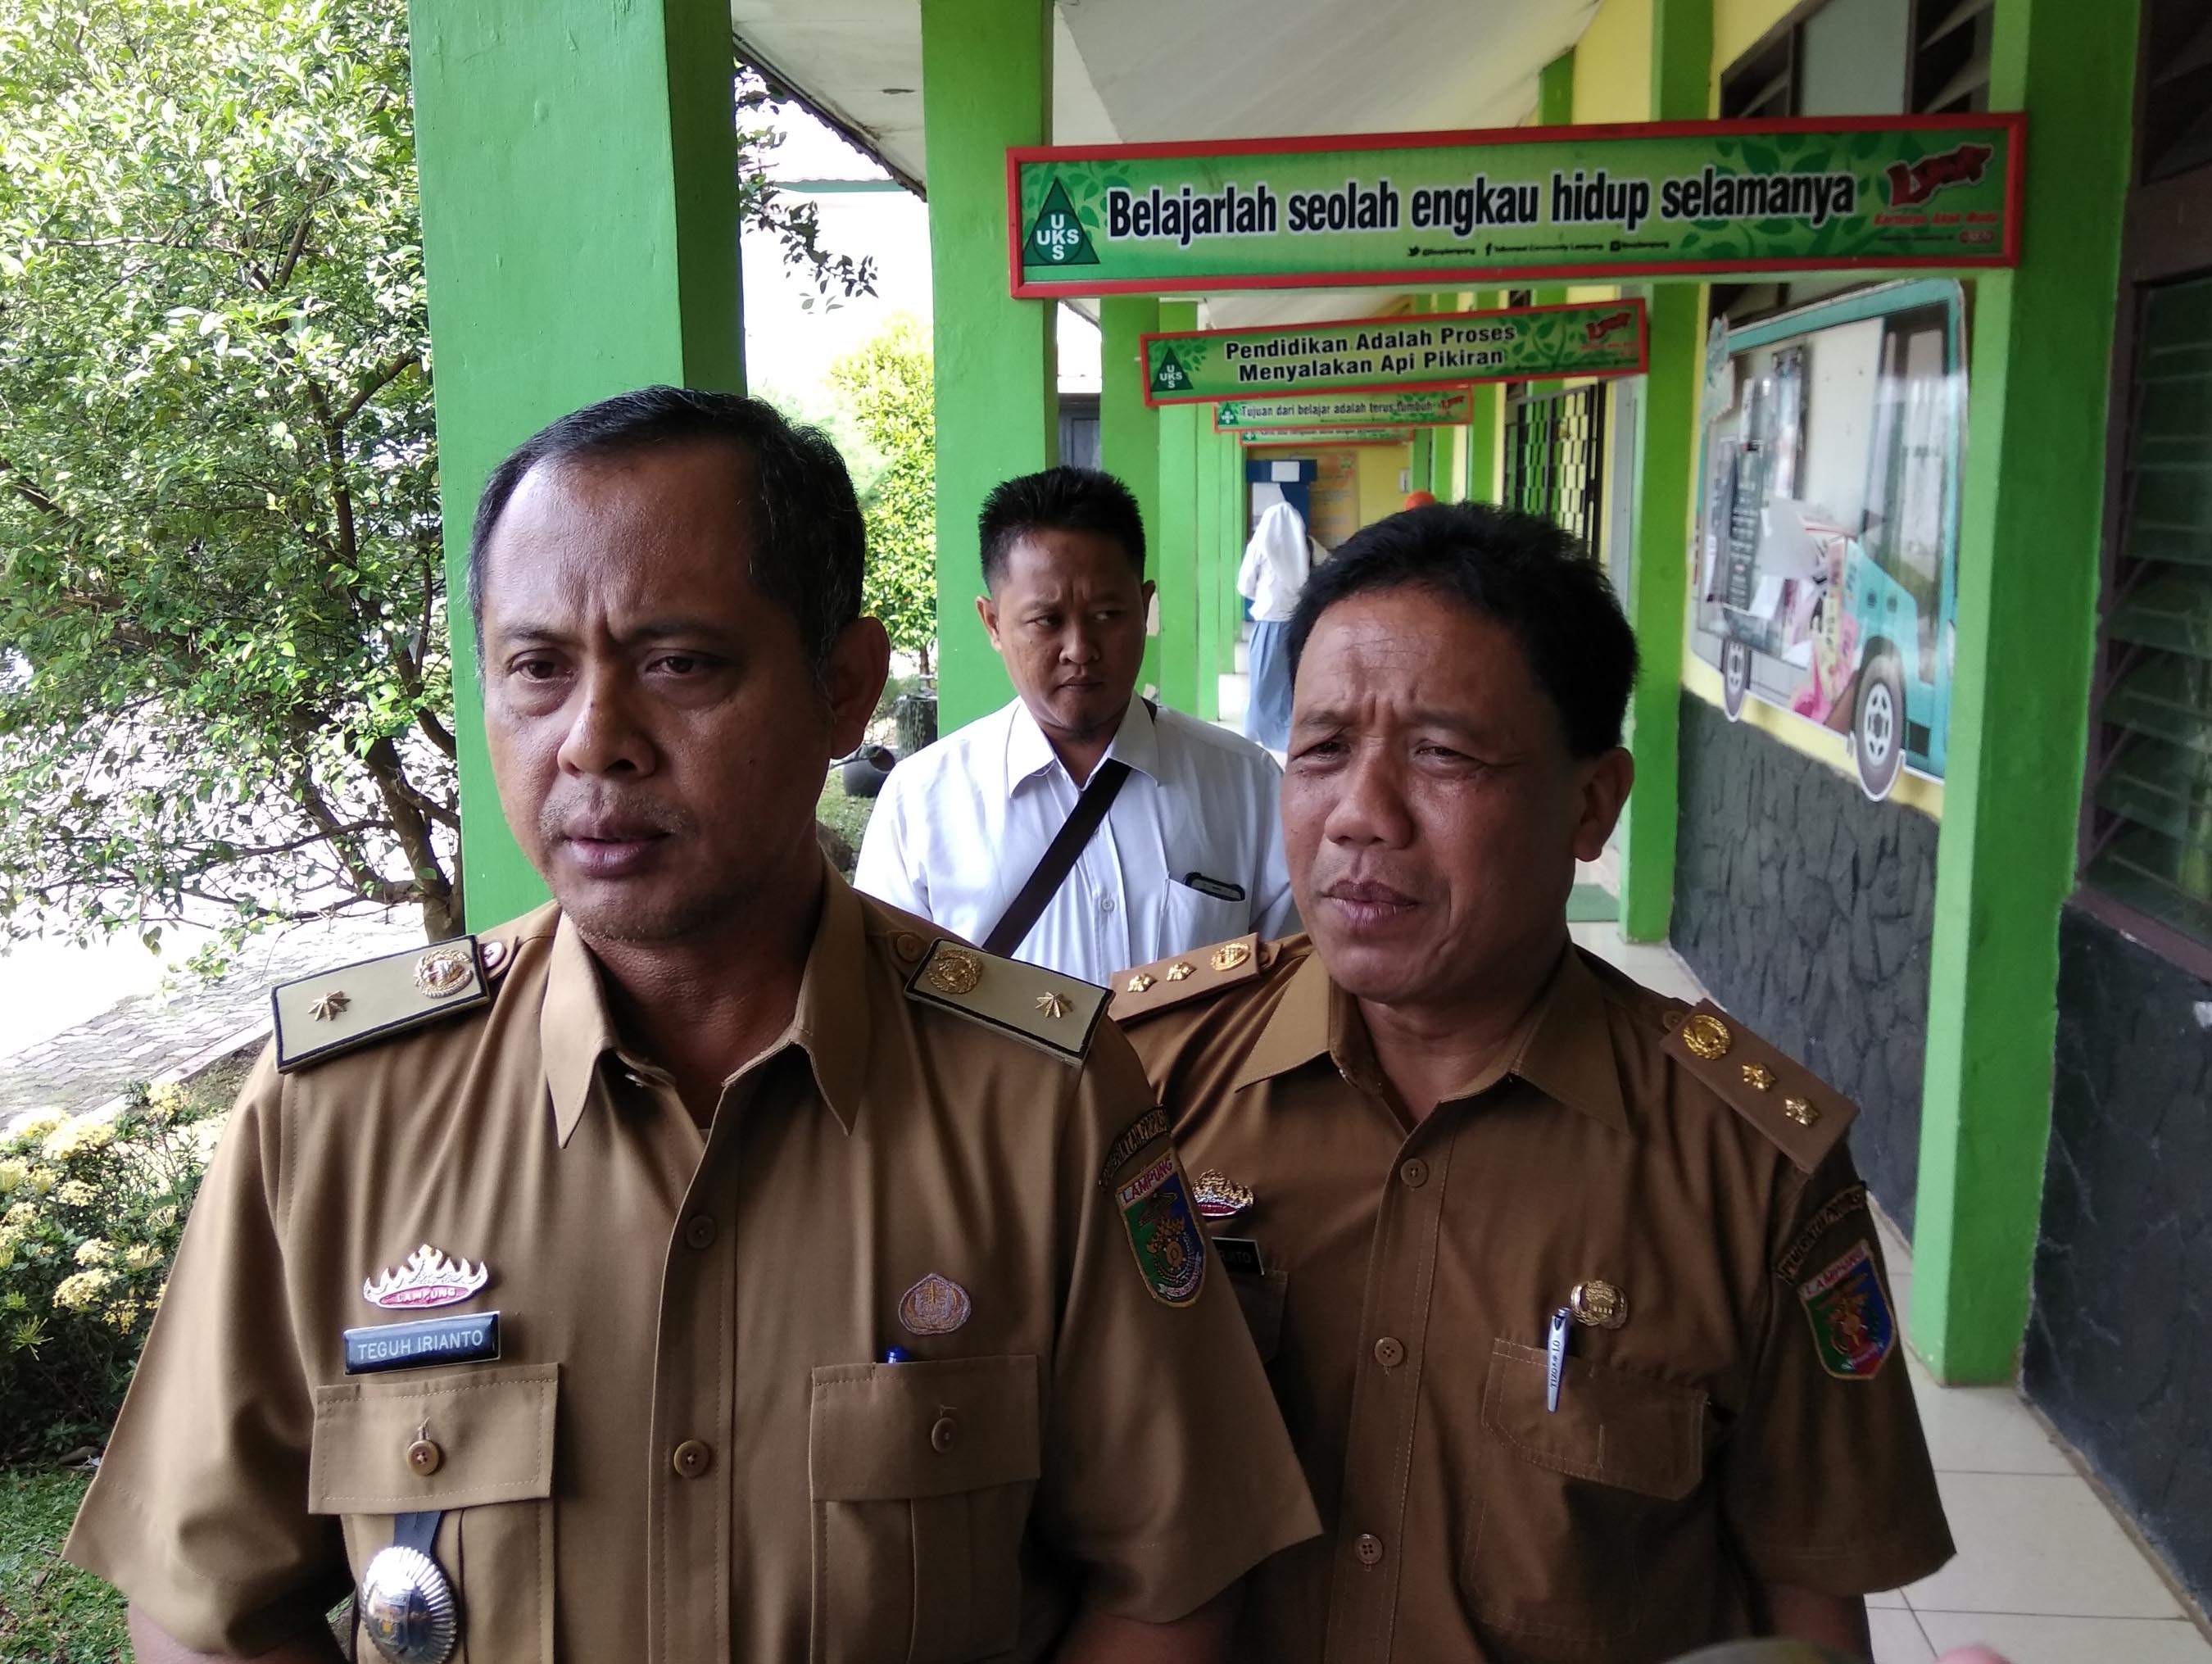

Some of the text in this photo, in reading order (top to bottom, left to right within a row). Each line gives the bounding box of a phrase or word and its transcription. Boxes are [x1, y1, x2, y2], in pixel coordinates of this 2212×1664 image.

[1109, 168, 1855, 247] Belajarlah seolah engkau hidup selamanya
[1226, 326, 1516, 360] Pendidikan Adalah Proses
[1239, 358, 1373, 383] Menyalakan
[1381, 352, 1415, 375] Api
[1423, 349, 1503, 369] Pikiran
[1241, 405, 1273, 419] Tujuan
[1276, 404, 1295, 416] dari
[1298, 403, 1330, 417] belajar
[1334, 402, 1367, 414] adalah
[1121, 1158, 1173, 1204] LAMPUNG
[397, 1287, 456, 1303] LAMPUNG
[357, 1329, 484, 1360] TEGUH IRIANTO
